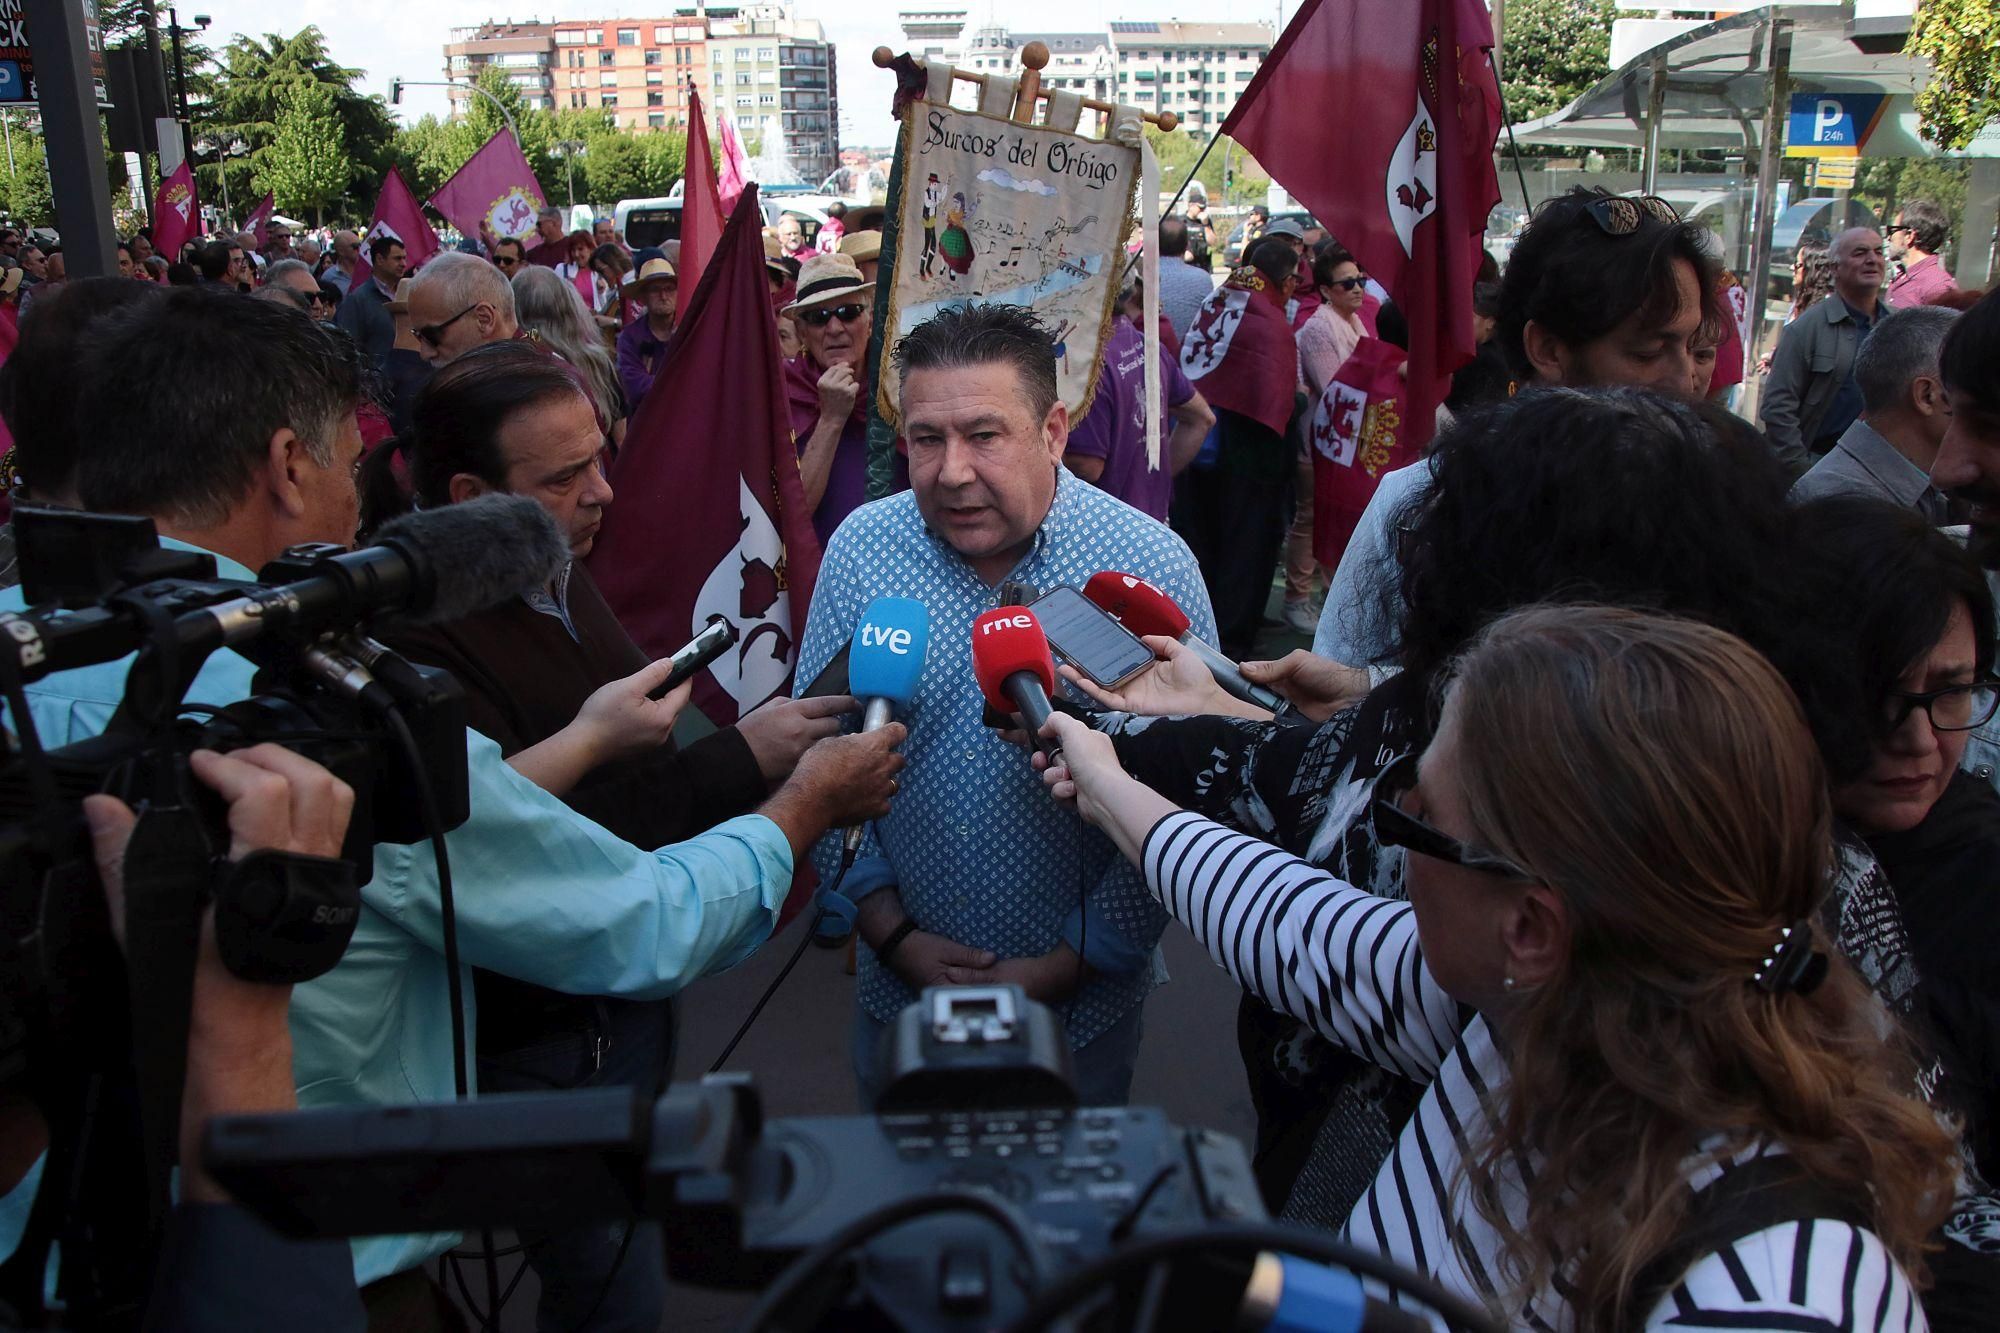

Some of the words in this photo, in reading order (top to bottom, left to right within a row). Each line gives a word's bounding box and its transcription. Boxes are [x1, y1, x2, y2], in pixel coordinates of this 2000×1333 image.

[1813, 100, 1843, 142] P
[1824, 130, 1843, 141] 24h
[920, 111, 1004, 157] Surcos
[1008, 138, 1038, 167] del
[861, 622, 912, 655] tve
[982, 614, 1033, 635] rne
